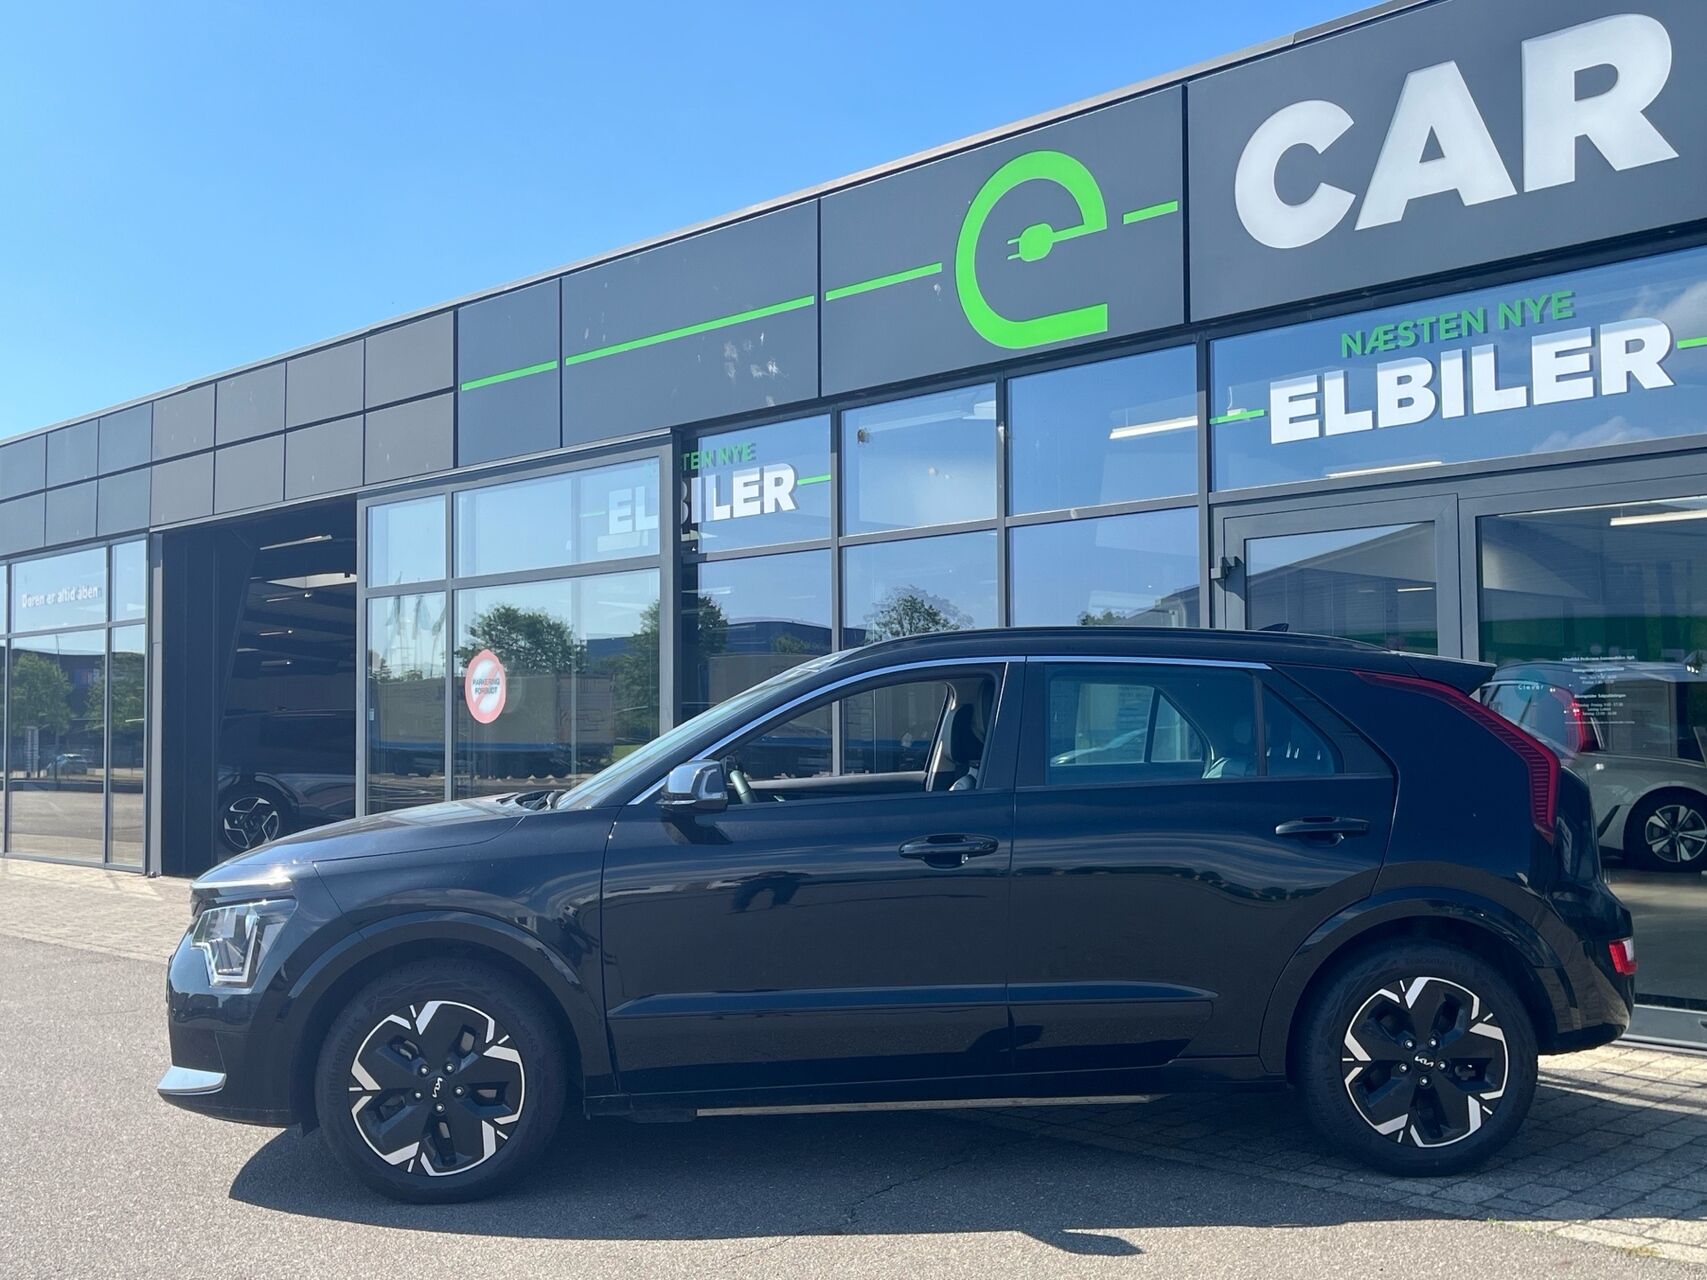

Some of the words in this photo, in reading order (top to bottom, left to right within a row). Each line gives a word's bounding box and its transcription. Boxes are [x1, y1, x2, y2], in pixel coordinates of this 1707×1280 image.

[1234, 13, 1680, 250] CAR
[1270, 318, 1674, 444] ELBILER
[1341, 307, 1484, 358] NÆSTEN
[1499, 290, 1573, 329] NYE
